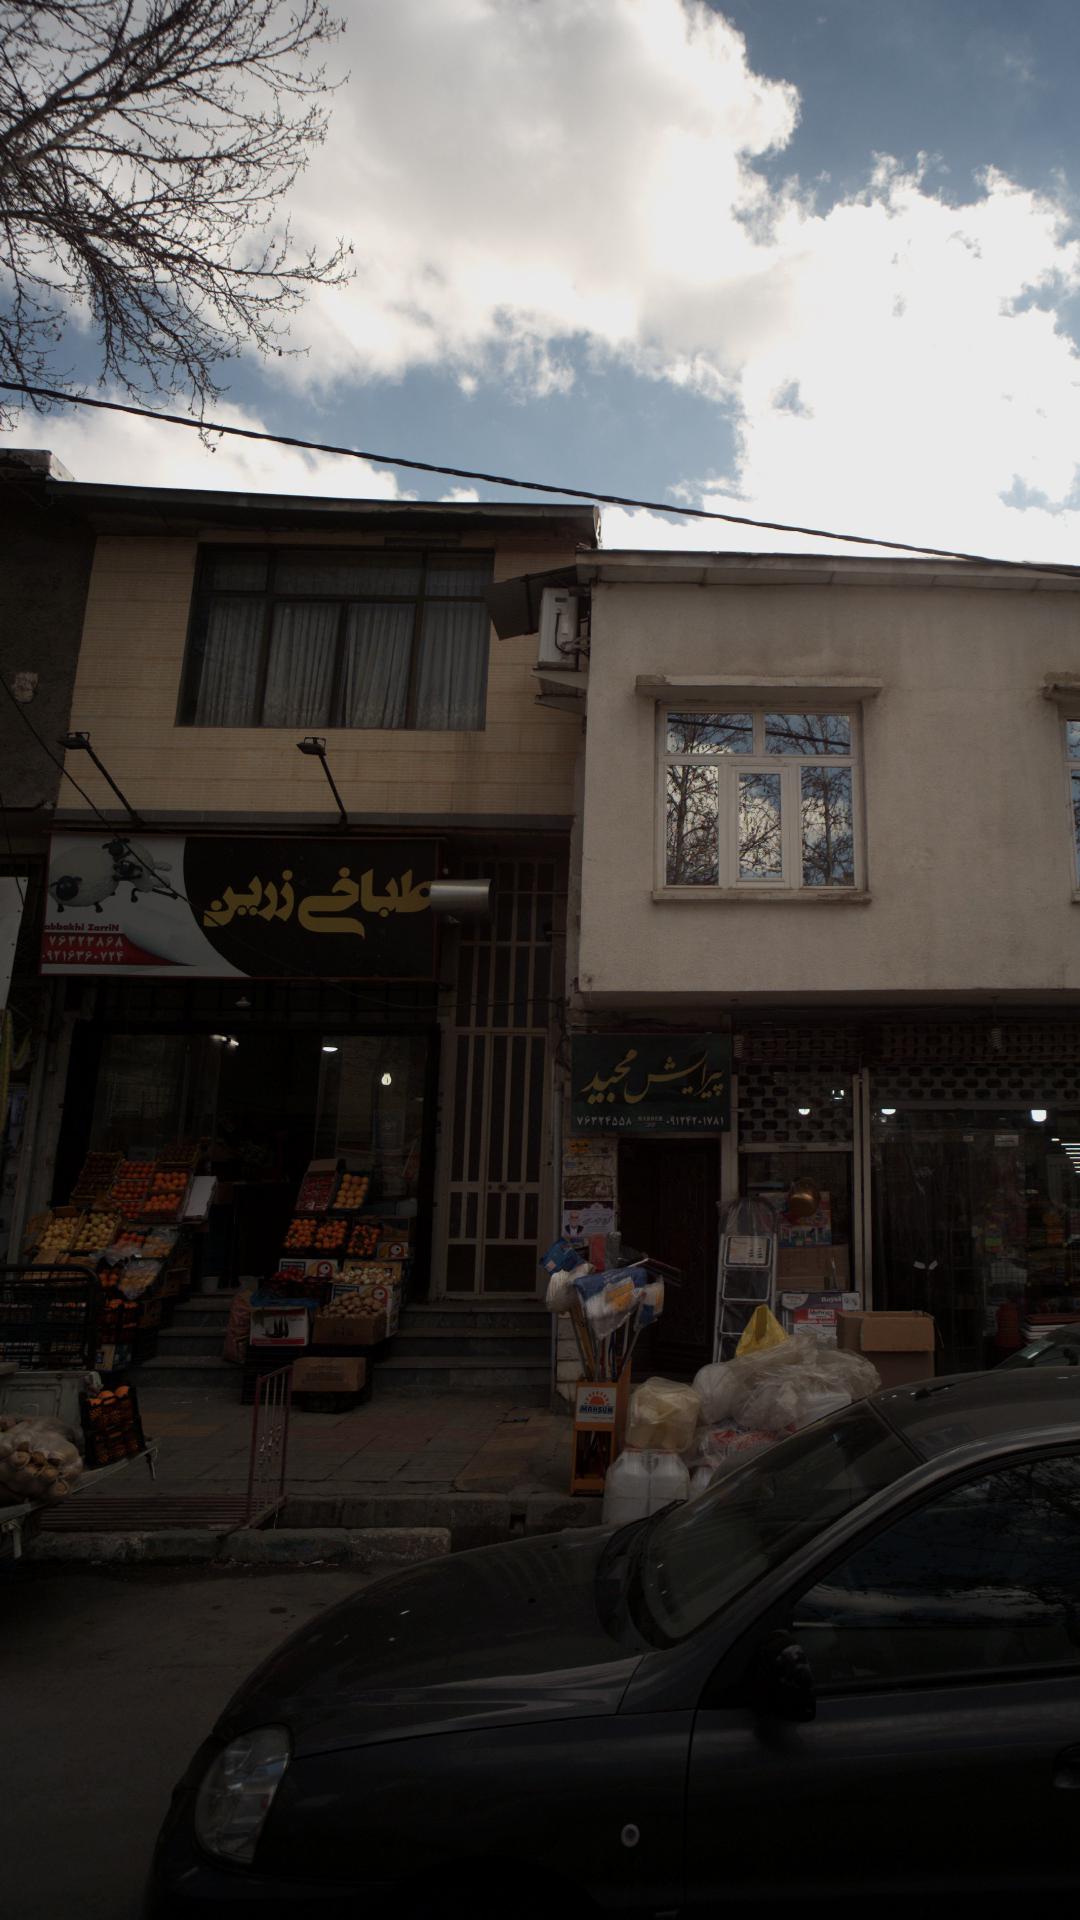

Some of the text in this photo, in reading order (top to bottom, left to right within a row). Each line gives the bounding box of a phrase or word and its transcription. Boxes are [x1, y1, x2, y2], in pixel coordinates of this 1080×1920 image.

[203, 866, 431, 940] طباخی زرین
[579, 1047, 724, 1105] پیرایش مجید
